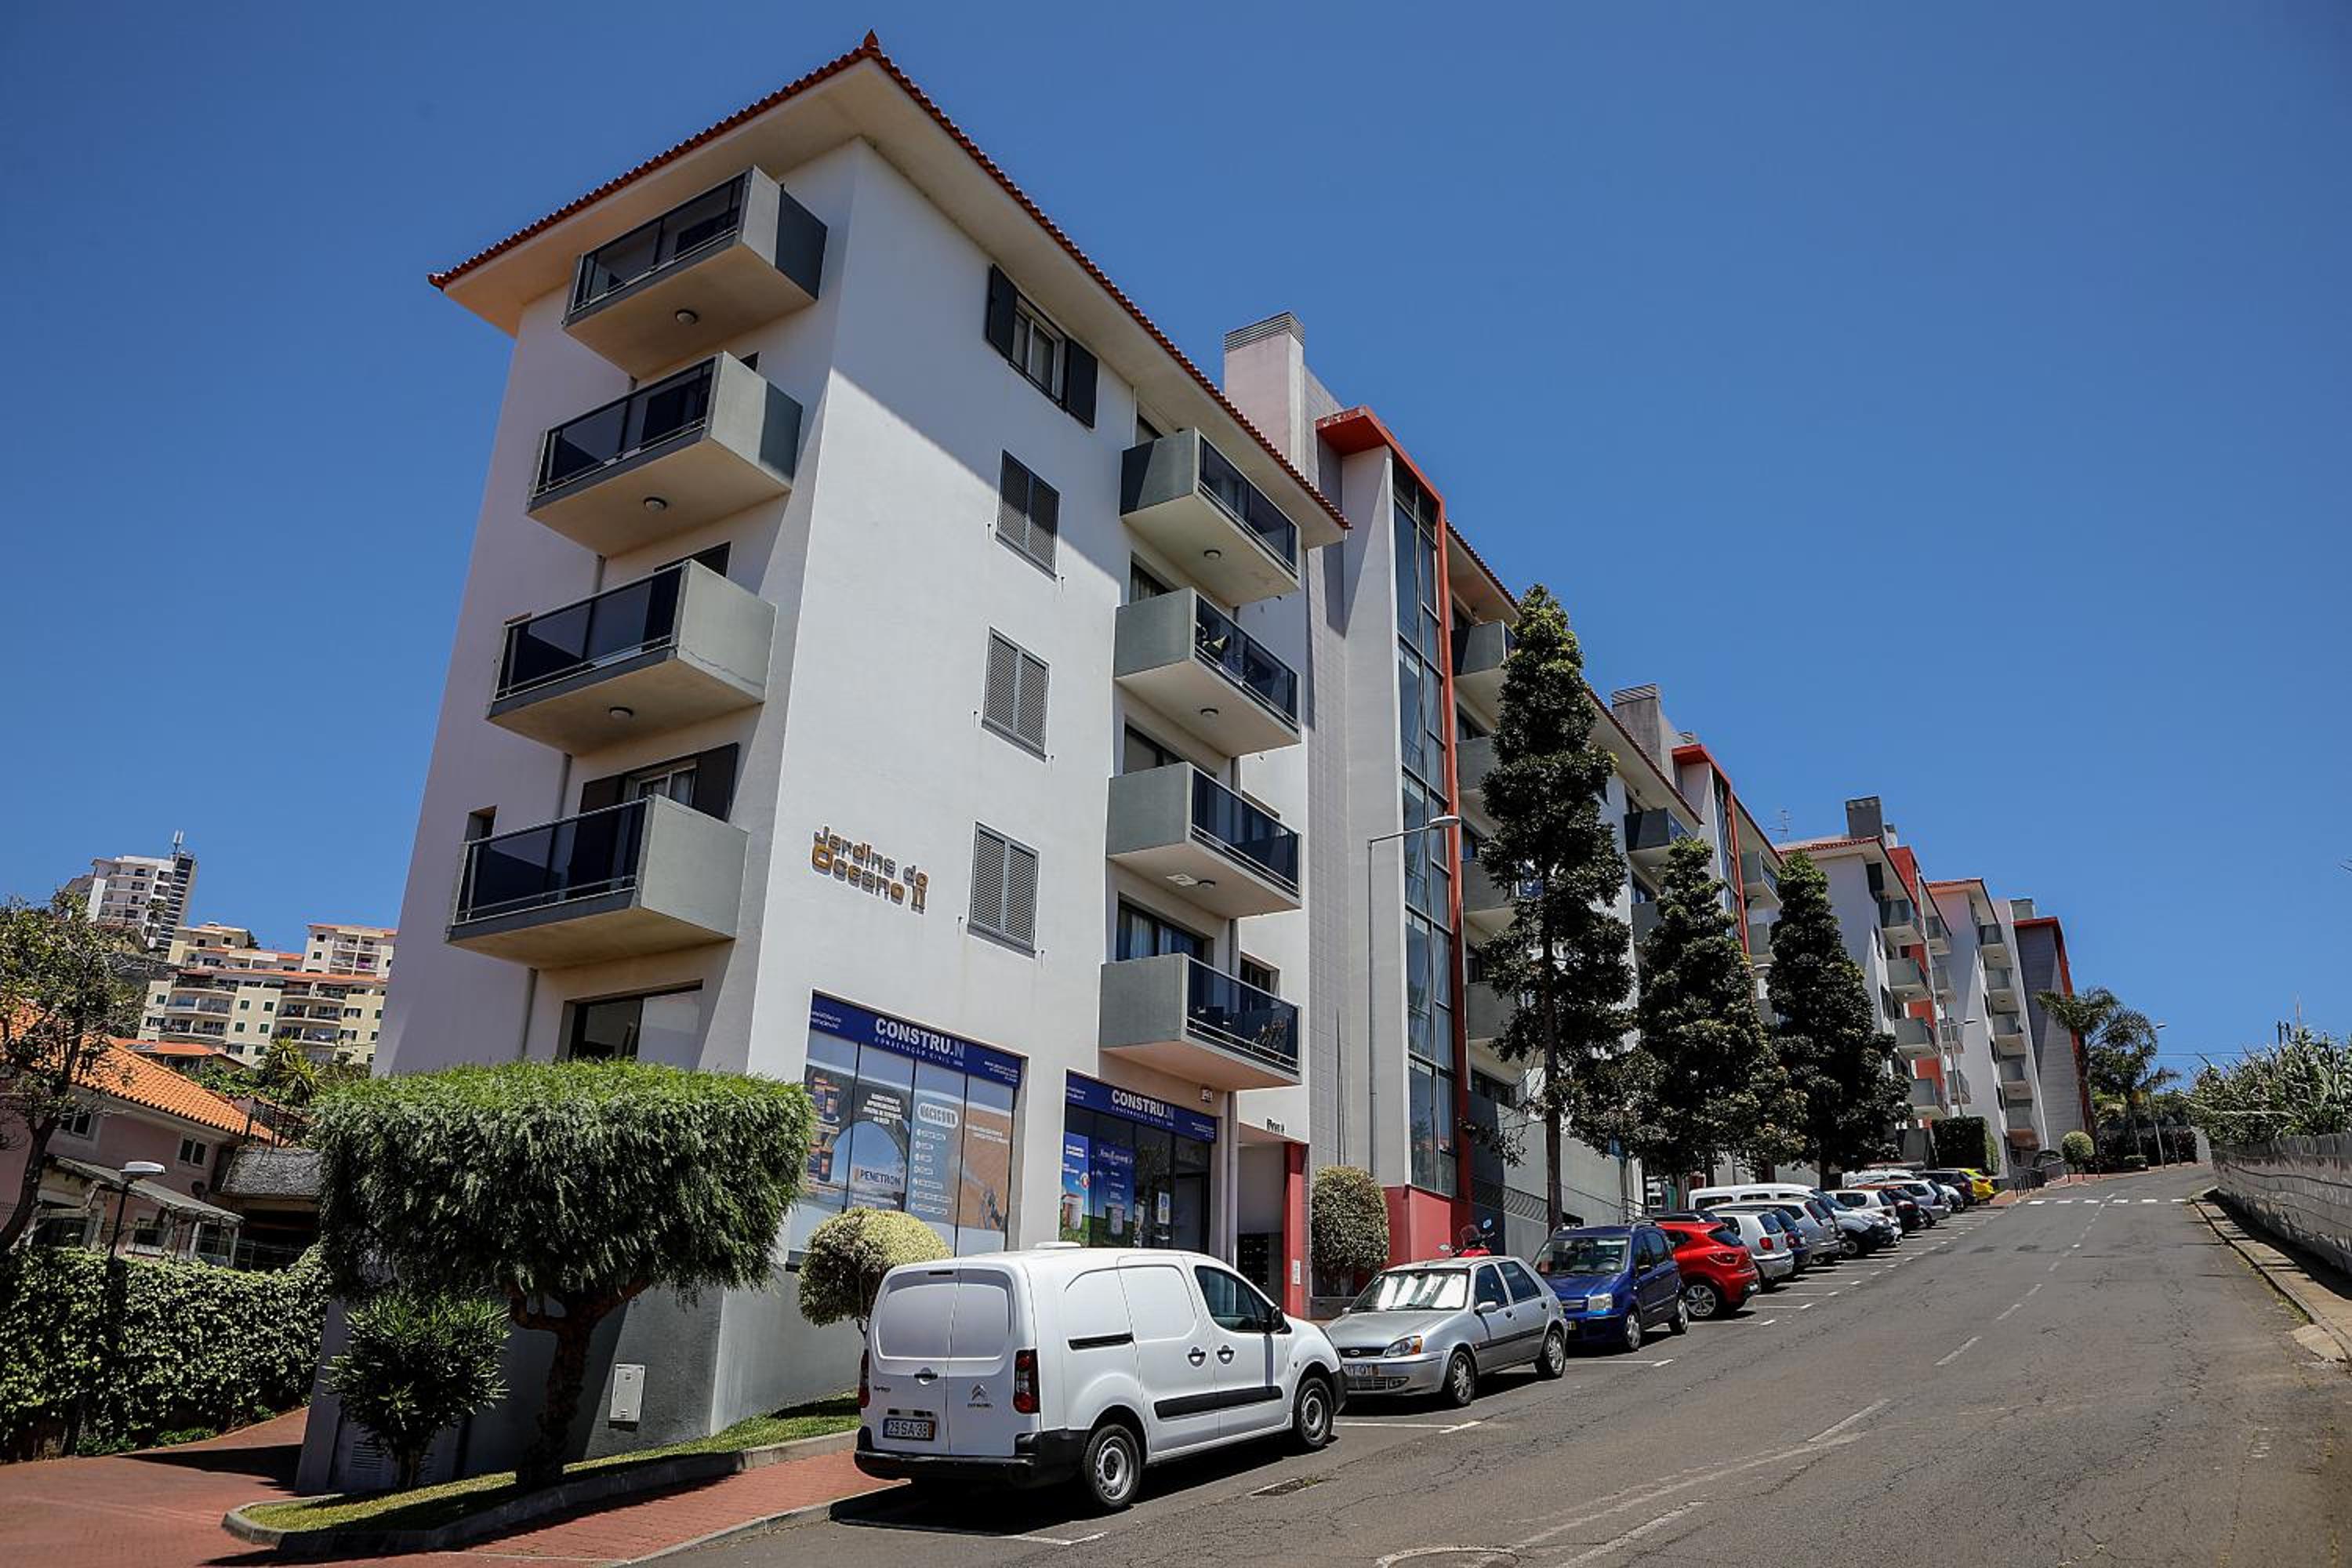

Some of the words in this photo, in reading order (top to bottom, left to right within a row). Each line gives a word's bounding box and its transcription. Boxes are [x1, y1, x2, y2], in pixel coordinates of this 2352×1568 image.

[812, 844, 905, 905] Oceano
[814, 826, 895, 878] Jardins
[903, 866, 928, 887] do
